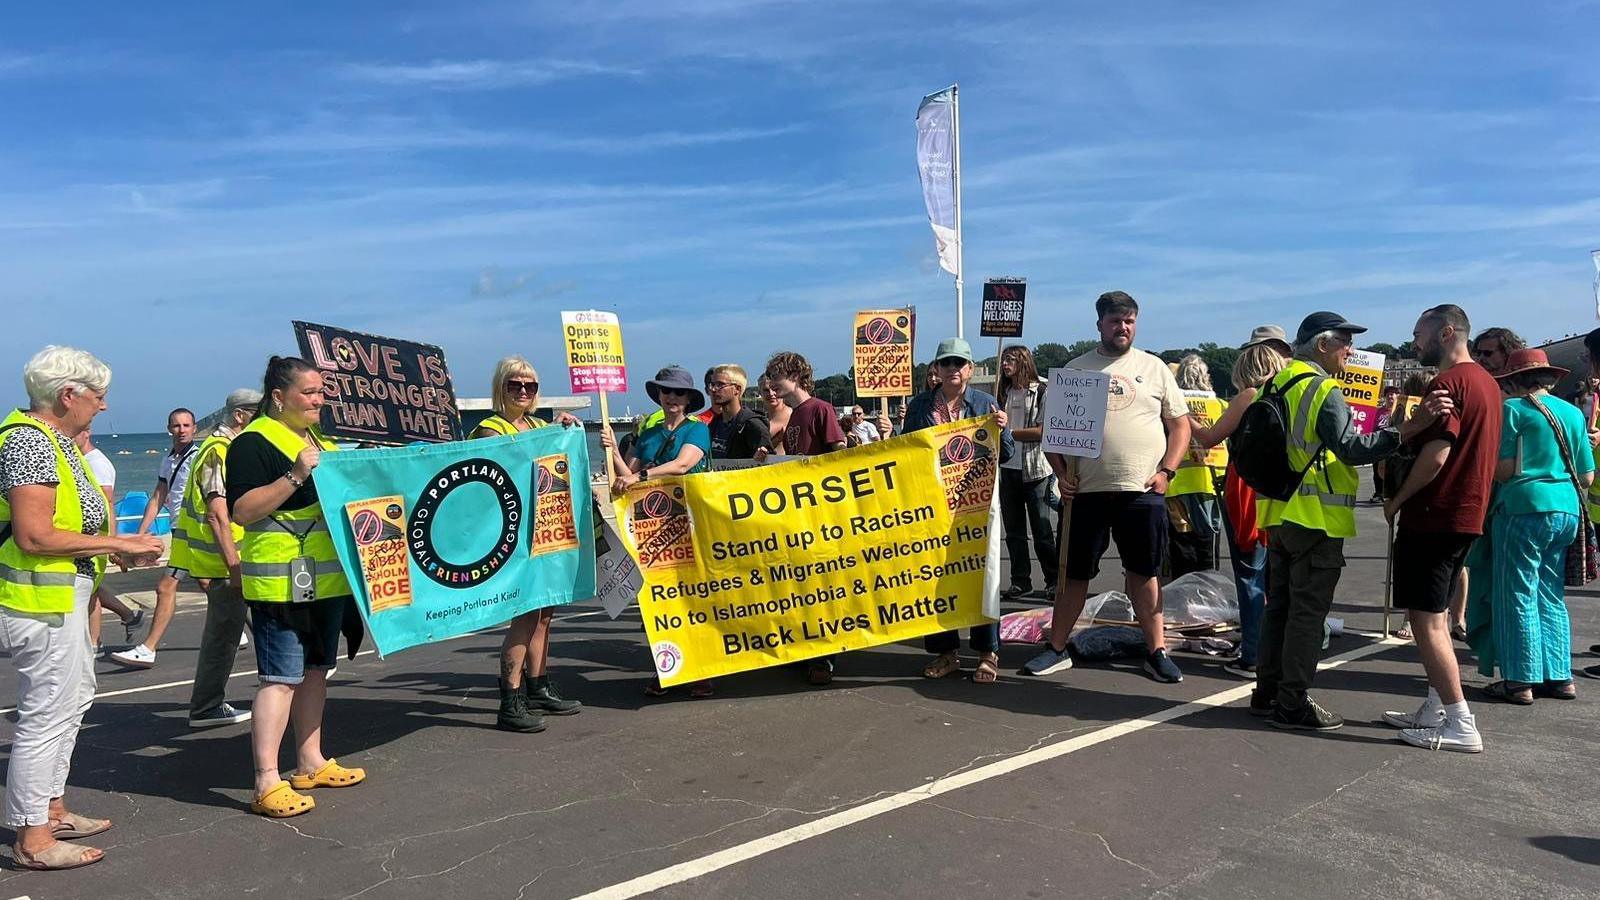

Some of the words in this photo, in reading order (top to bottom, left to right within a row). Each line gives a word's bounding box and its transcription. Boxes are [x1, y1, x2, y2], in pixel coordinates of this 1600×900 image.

[984, 300, 1023, 311] REFUGEES
[983, 311, 1022, 321] WELCOME
[567, 325, 609, 339] Oppose
[569, 338, 609, 351] Tommy
[306, 329, 406, 382] LOVE
[417, 353, 447, 386] IS
[570, 352, 622, 363] Robinson
[856, 356, 876, 364] THE
[573, 368, 591, 376] Stop
[1332, 370, 1378, 385] ugees
[596, 376, 607, 384] far
[609, 377, 625, 385] right
[858, 375, 911, 388] BARGE
[1056, 373, 1101, 387] DORSET
[320, 370, 458, 415] STRONGER
[1066, 404, 1086, 417] NO
[324, 399, 388, 428] THAN
[400, 408, 453, 441] HATE
[1050, 416, 1096, 431] RACIST
[1046, 434, 1096, 448] VIOLENCE
[941, 465, 961, 475] NOW
[429, 464, 505, 500] PORTLAND
[943, 475, 961, 486] THE
[727, 460, 898, 520] DORSET
[947, 489, 991, 511] BARG
[635, 520, 657, 529] NOW
[412, 508, 432, 567] GLOBAL
[429, 543, 511, 583] FRIENDSHIP
[503, 492, 519, 543] GROUP
[535, 526, 575, 545] ARGE
[636, 529, 657, 540] THE
[711, 532, 778, 560] Stand
[785, 531, 815, 550] up
[821, 524, 844, 542] to
[849, 504, 935, 536] Racism
[650, 570, 743, 602] Refugees
[749, 568, 765, 585] &
[769, 554, 857, 584] Migrants
[861, 534, 952, 564] Welcome
[371, 578, 410, 600] RGE
[654, 614, 682, 632] No
[687, 609, 708, 624] to
[712, 587, 848, 621] Islamophobia
[852, 579, 867, 595] &
[873, 552, 988, 592] Anti-Semitis
[425, 604, 462, 621] Keeping
[463, 595, 499, 611] Portland
[501, 588, 521, 603] Kind!
[721, 625, 796, 656] Black
[801, 611, 872, 640] Lives
[877, 593, 959, 625] Matter
